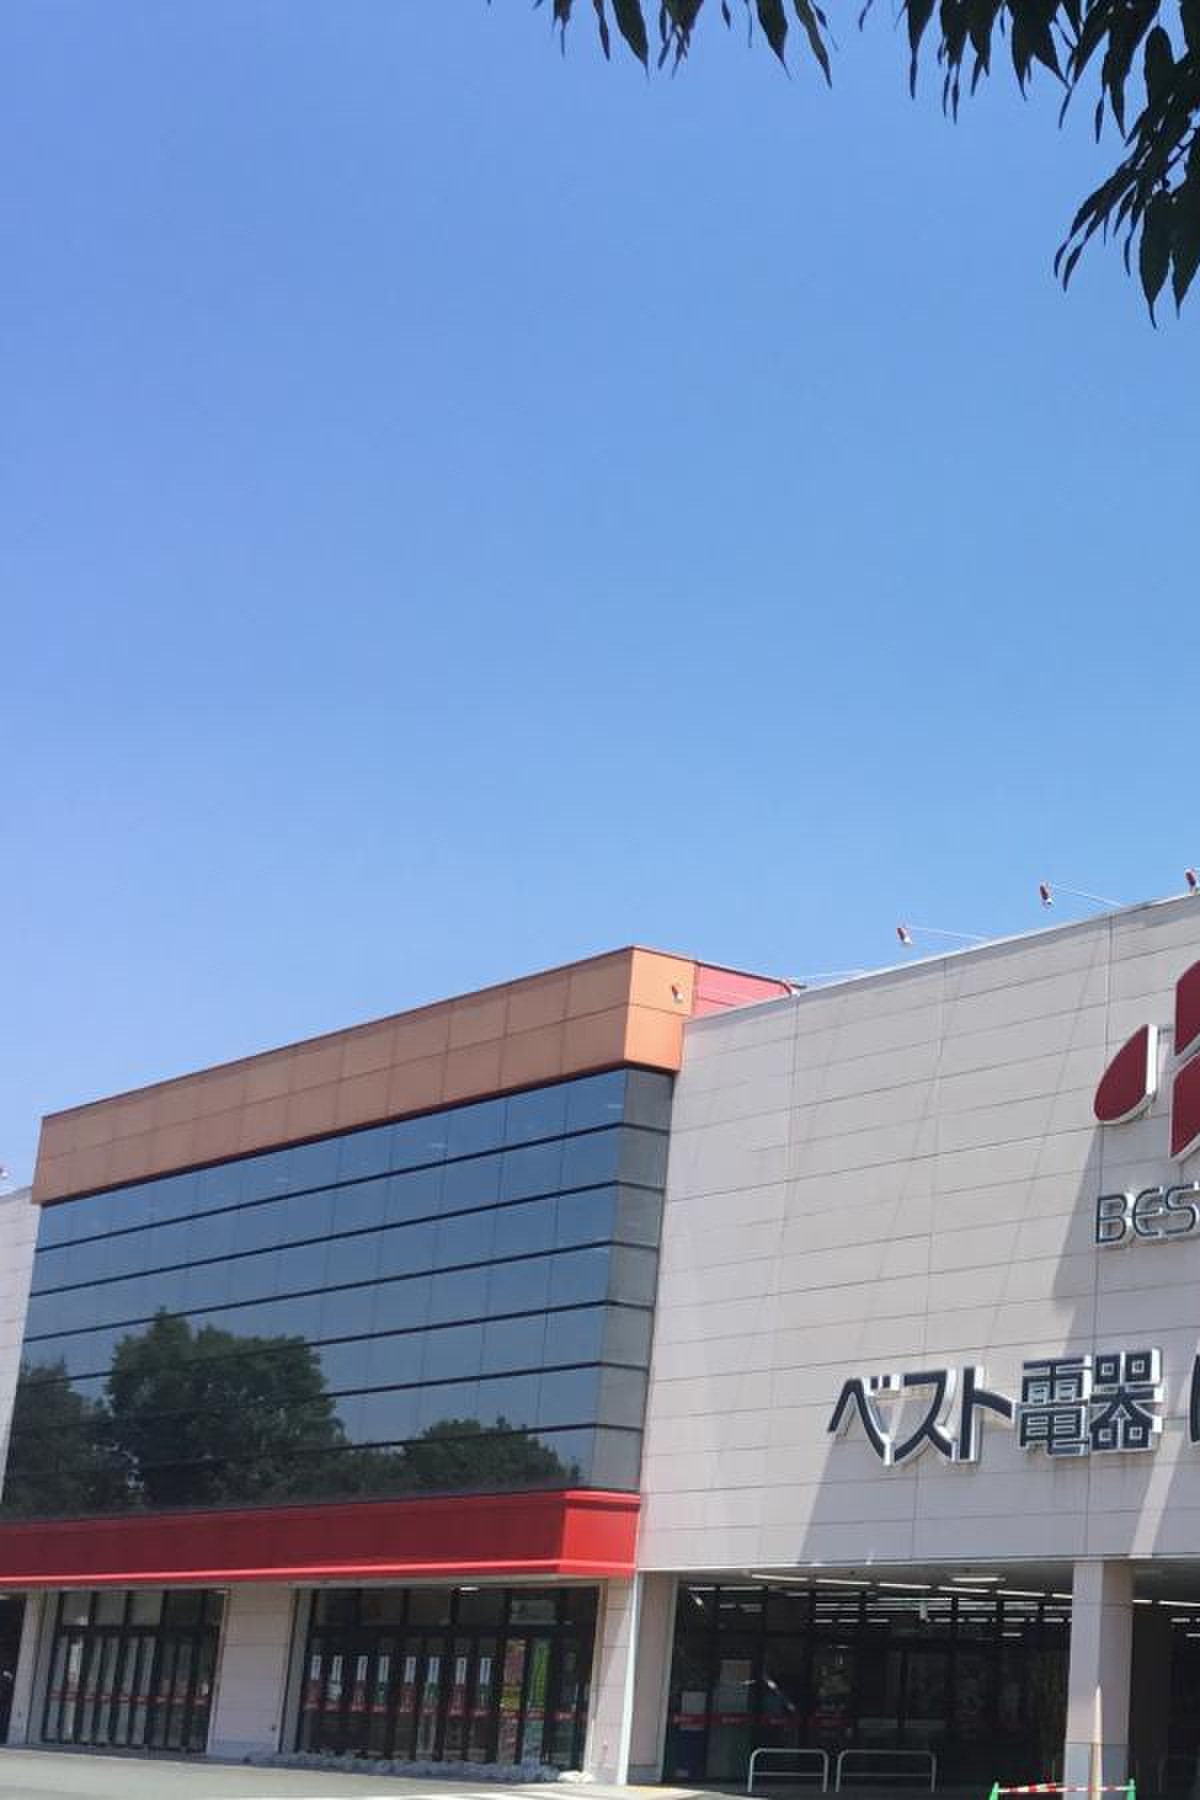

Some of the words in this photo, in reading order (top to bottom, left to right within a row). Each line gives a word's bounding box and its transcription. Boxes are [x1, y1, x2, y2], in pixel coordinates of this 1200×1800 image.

[828, 1348, 1162, 1466] ベスト電器
